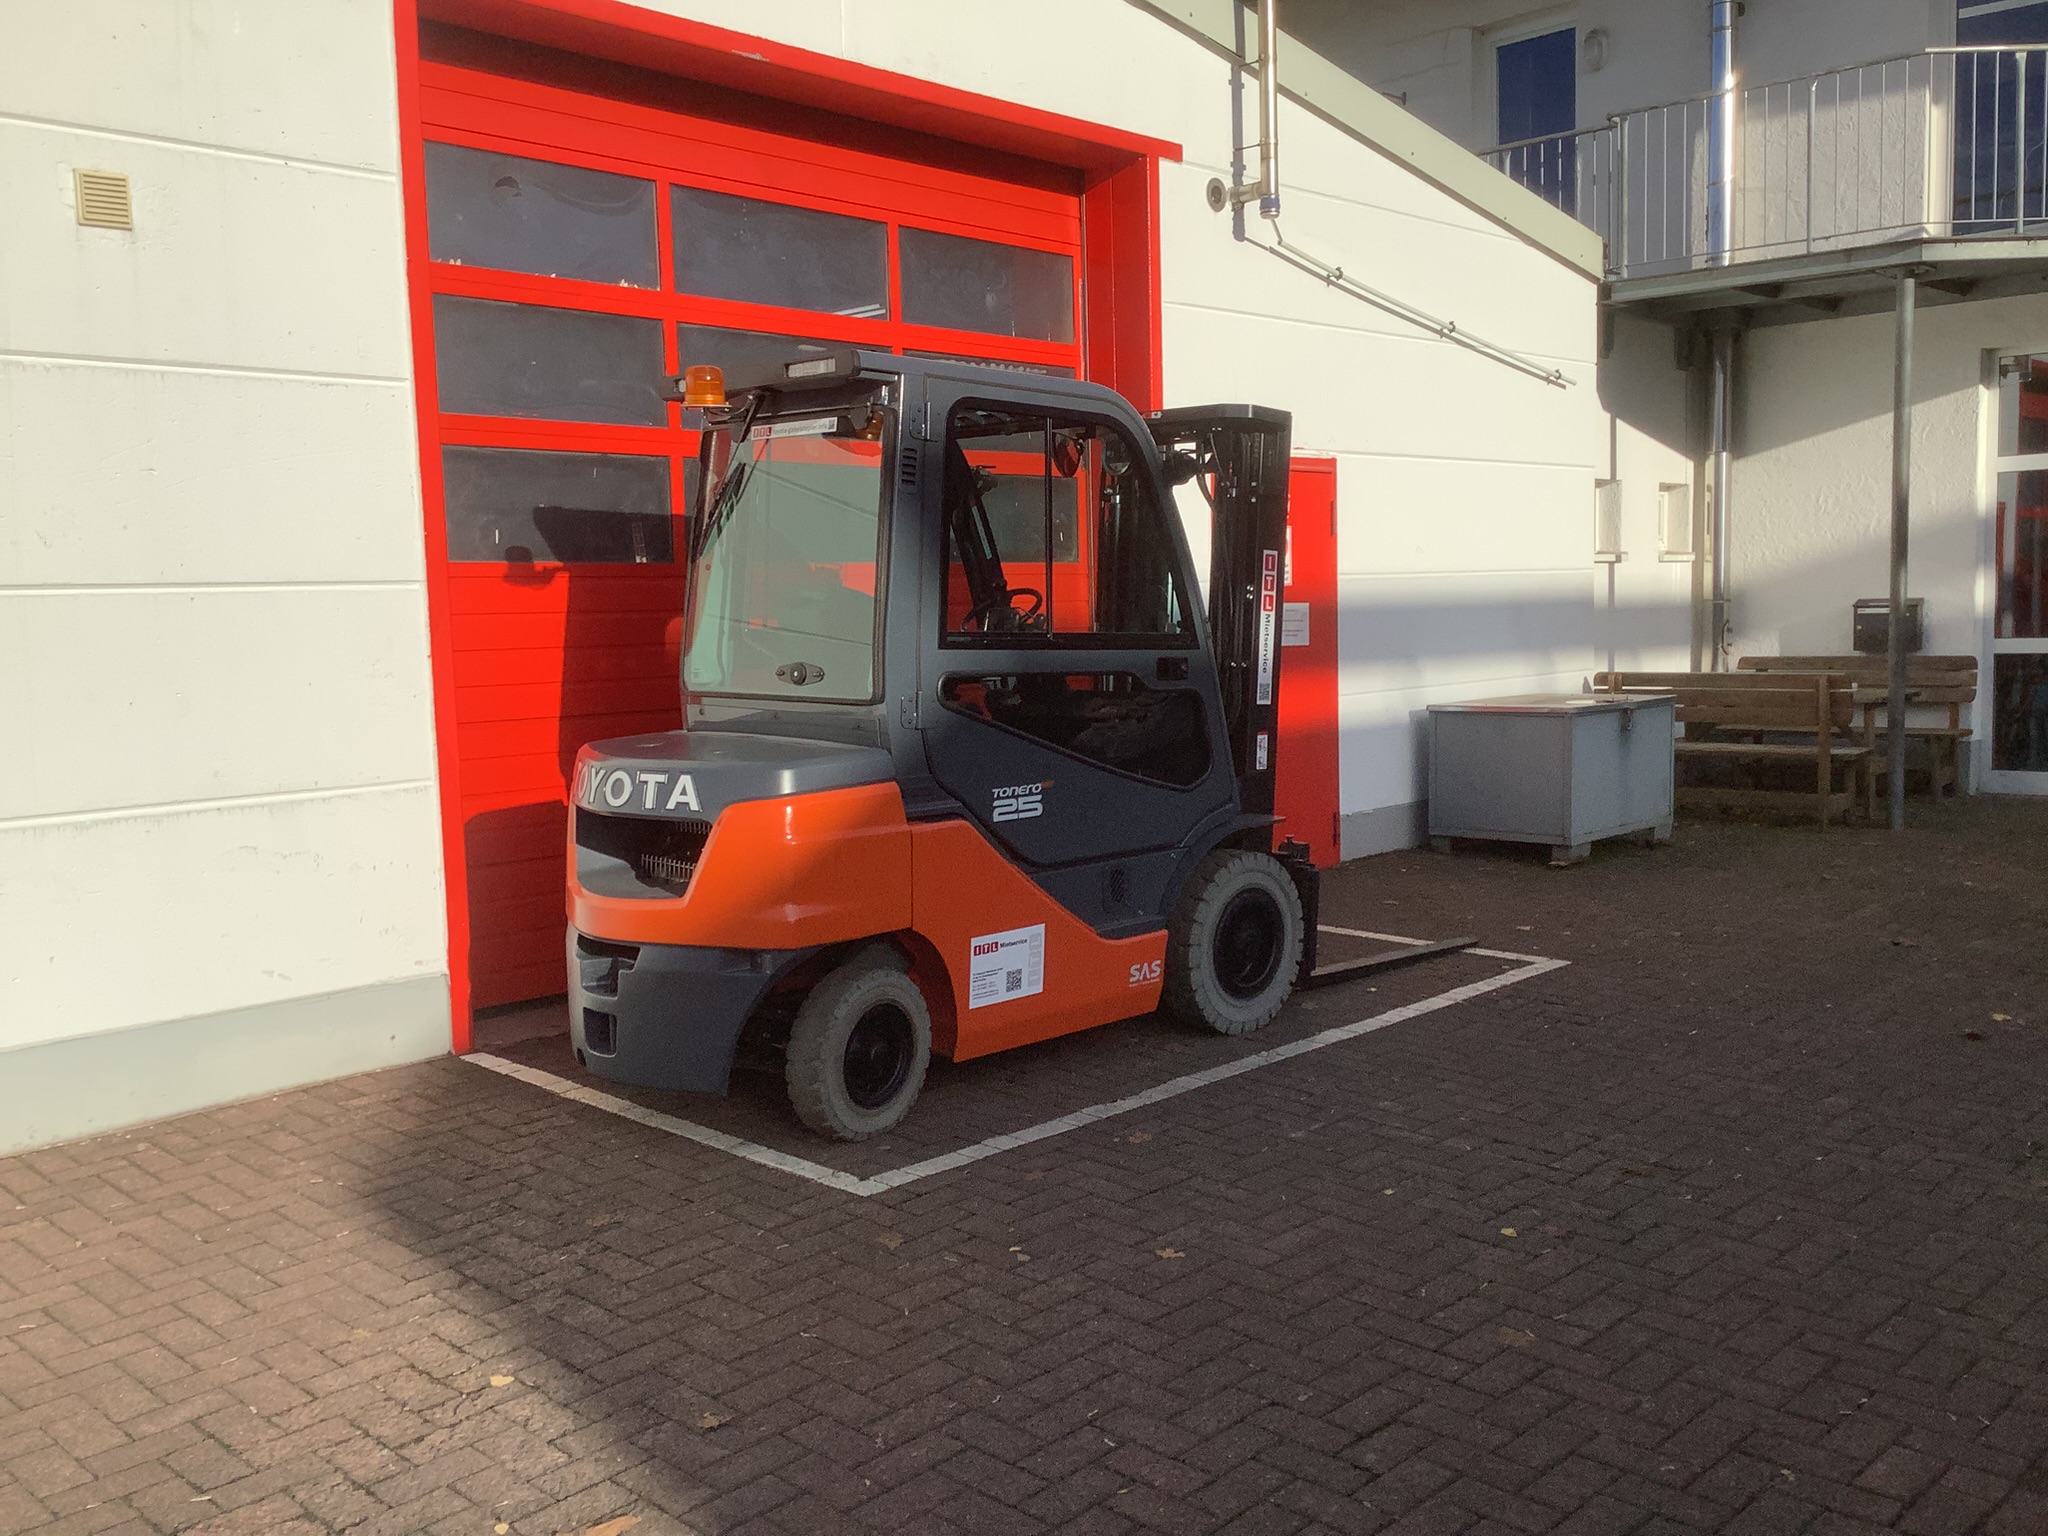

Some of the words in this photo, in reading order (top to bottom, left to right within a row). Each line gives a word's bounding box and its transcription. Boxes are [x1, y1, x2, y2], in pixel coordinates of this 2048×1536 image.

[1263, 554, 1276, 612] ITL
[1262, 613, 1271, 674] Mietservice
[993, 795, 1043, 823] 25
[974, 942, 998, 956] ITL
[1000, 939, 1028, 949] Mietservice
[1130, 960, 1161, 982] SAS
